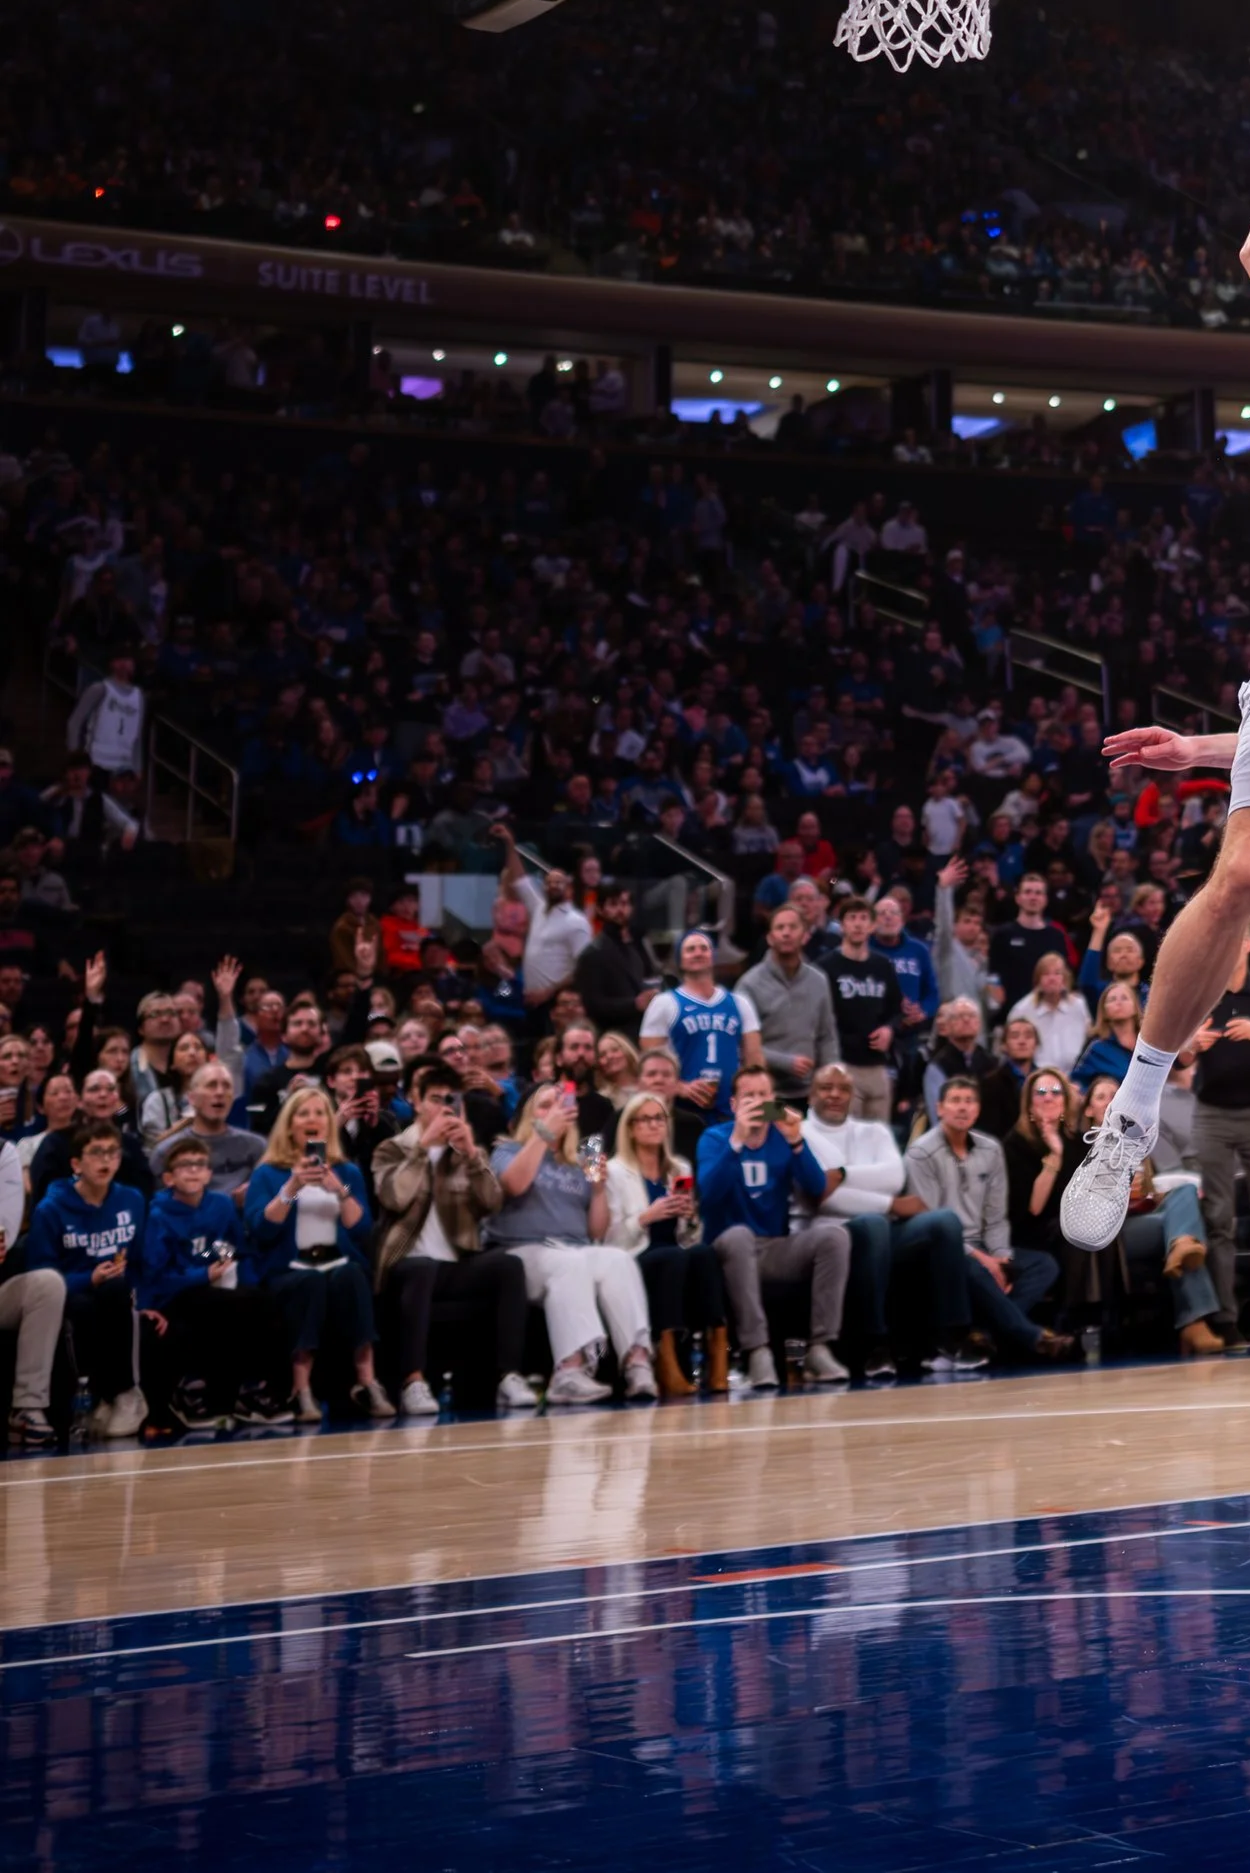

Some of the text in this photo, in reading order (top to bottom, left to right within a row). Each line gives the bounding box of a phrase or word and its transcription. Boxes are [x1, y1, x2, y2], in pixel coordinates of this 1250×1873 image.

[29, 237, 434, 305] LEXUS SUITE LEVEL
[893, 957, 921, 977] KE
[836, 974, 886, 999] Duke
[681, 1012, 740, 1036] DUKE
[705, 1032, 718, 1064] 1
[741, 1160, 768, 1188] D
